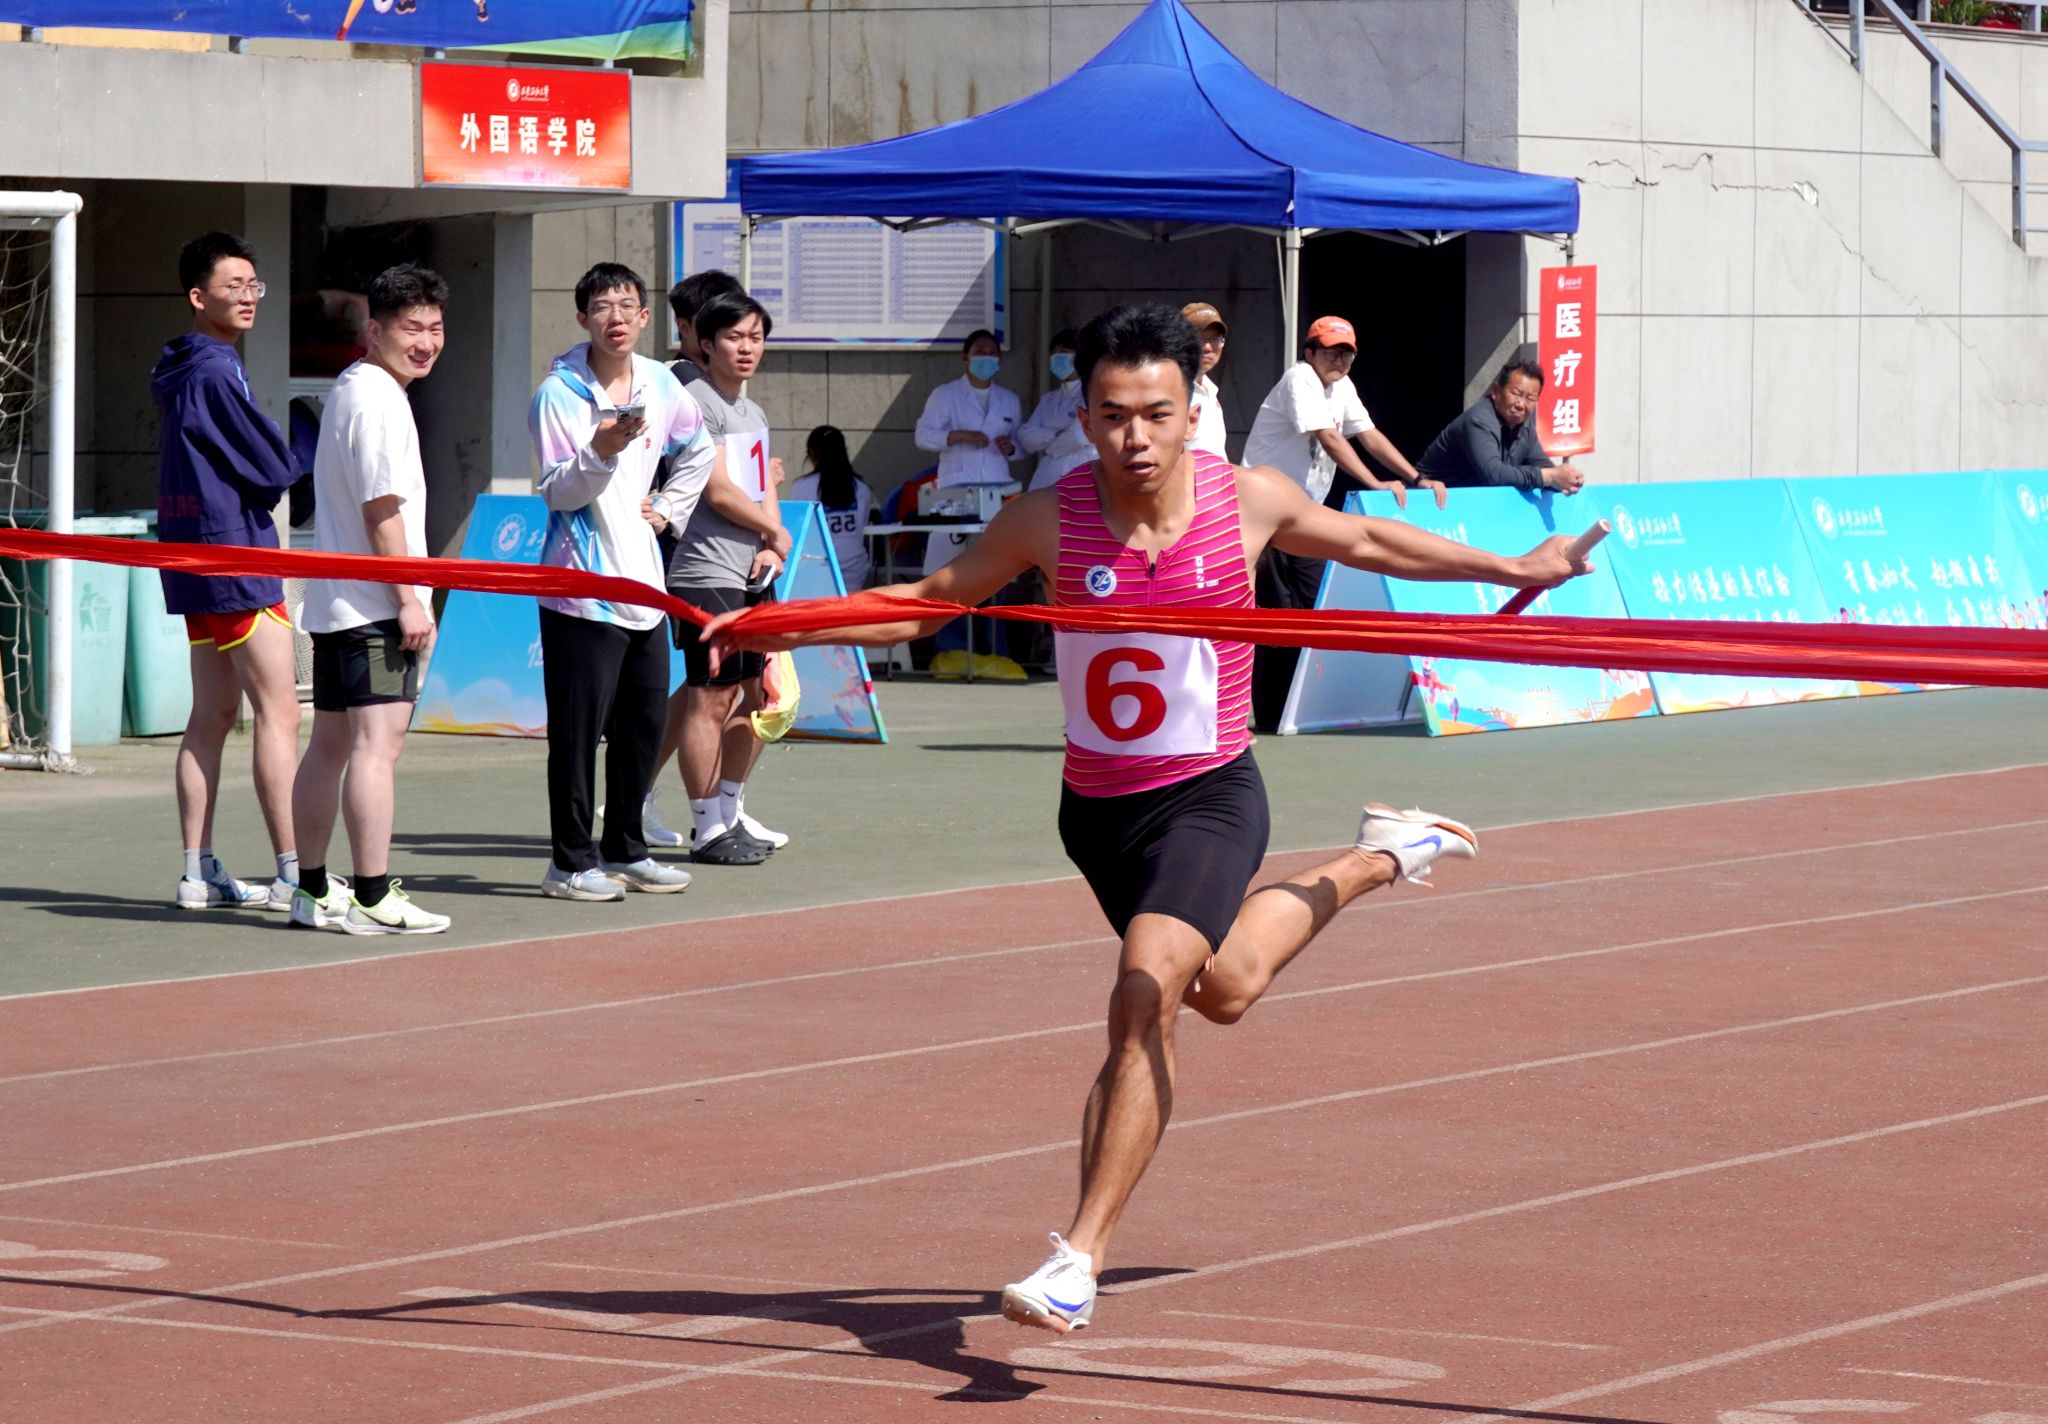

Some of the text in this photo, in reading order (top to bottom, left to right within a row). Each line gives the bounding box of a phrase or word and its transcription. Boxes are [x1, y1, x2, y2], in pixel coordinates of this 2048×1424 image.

[460, 112, 597, 157] 外国语学院
[1552, 302, 1583, 435] 医疗组
[750, 440, 765, 492] 1
[1085, 647, 1167, 742] 6
